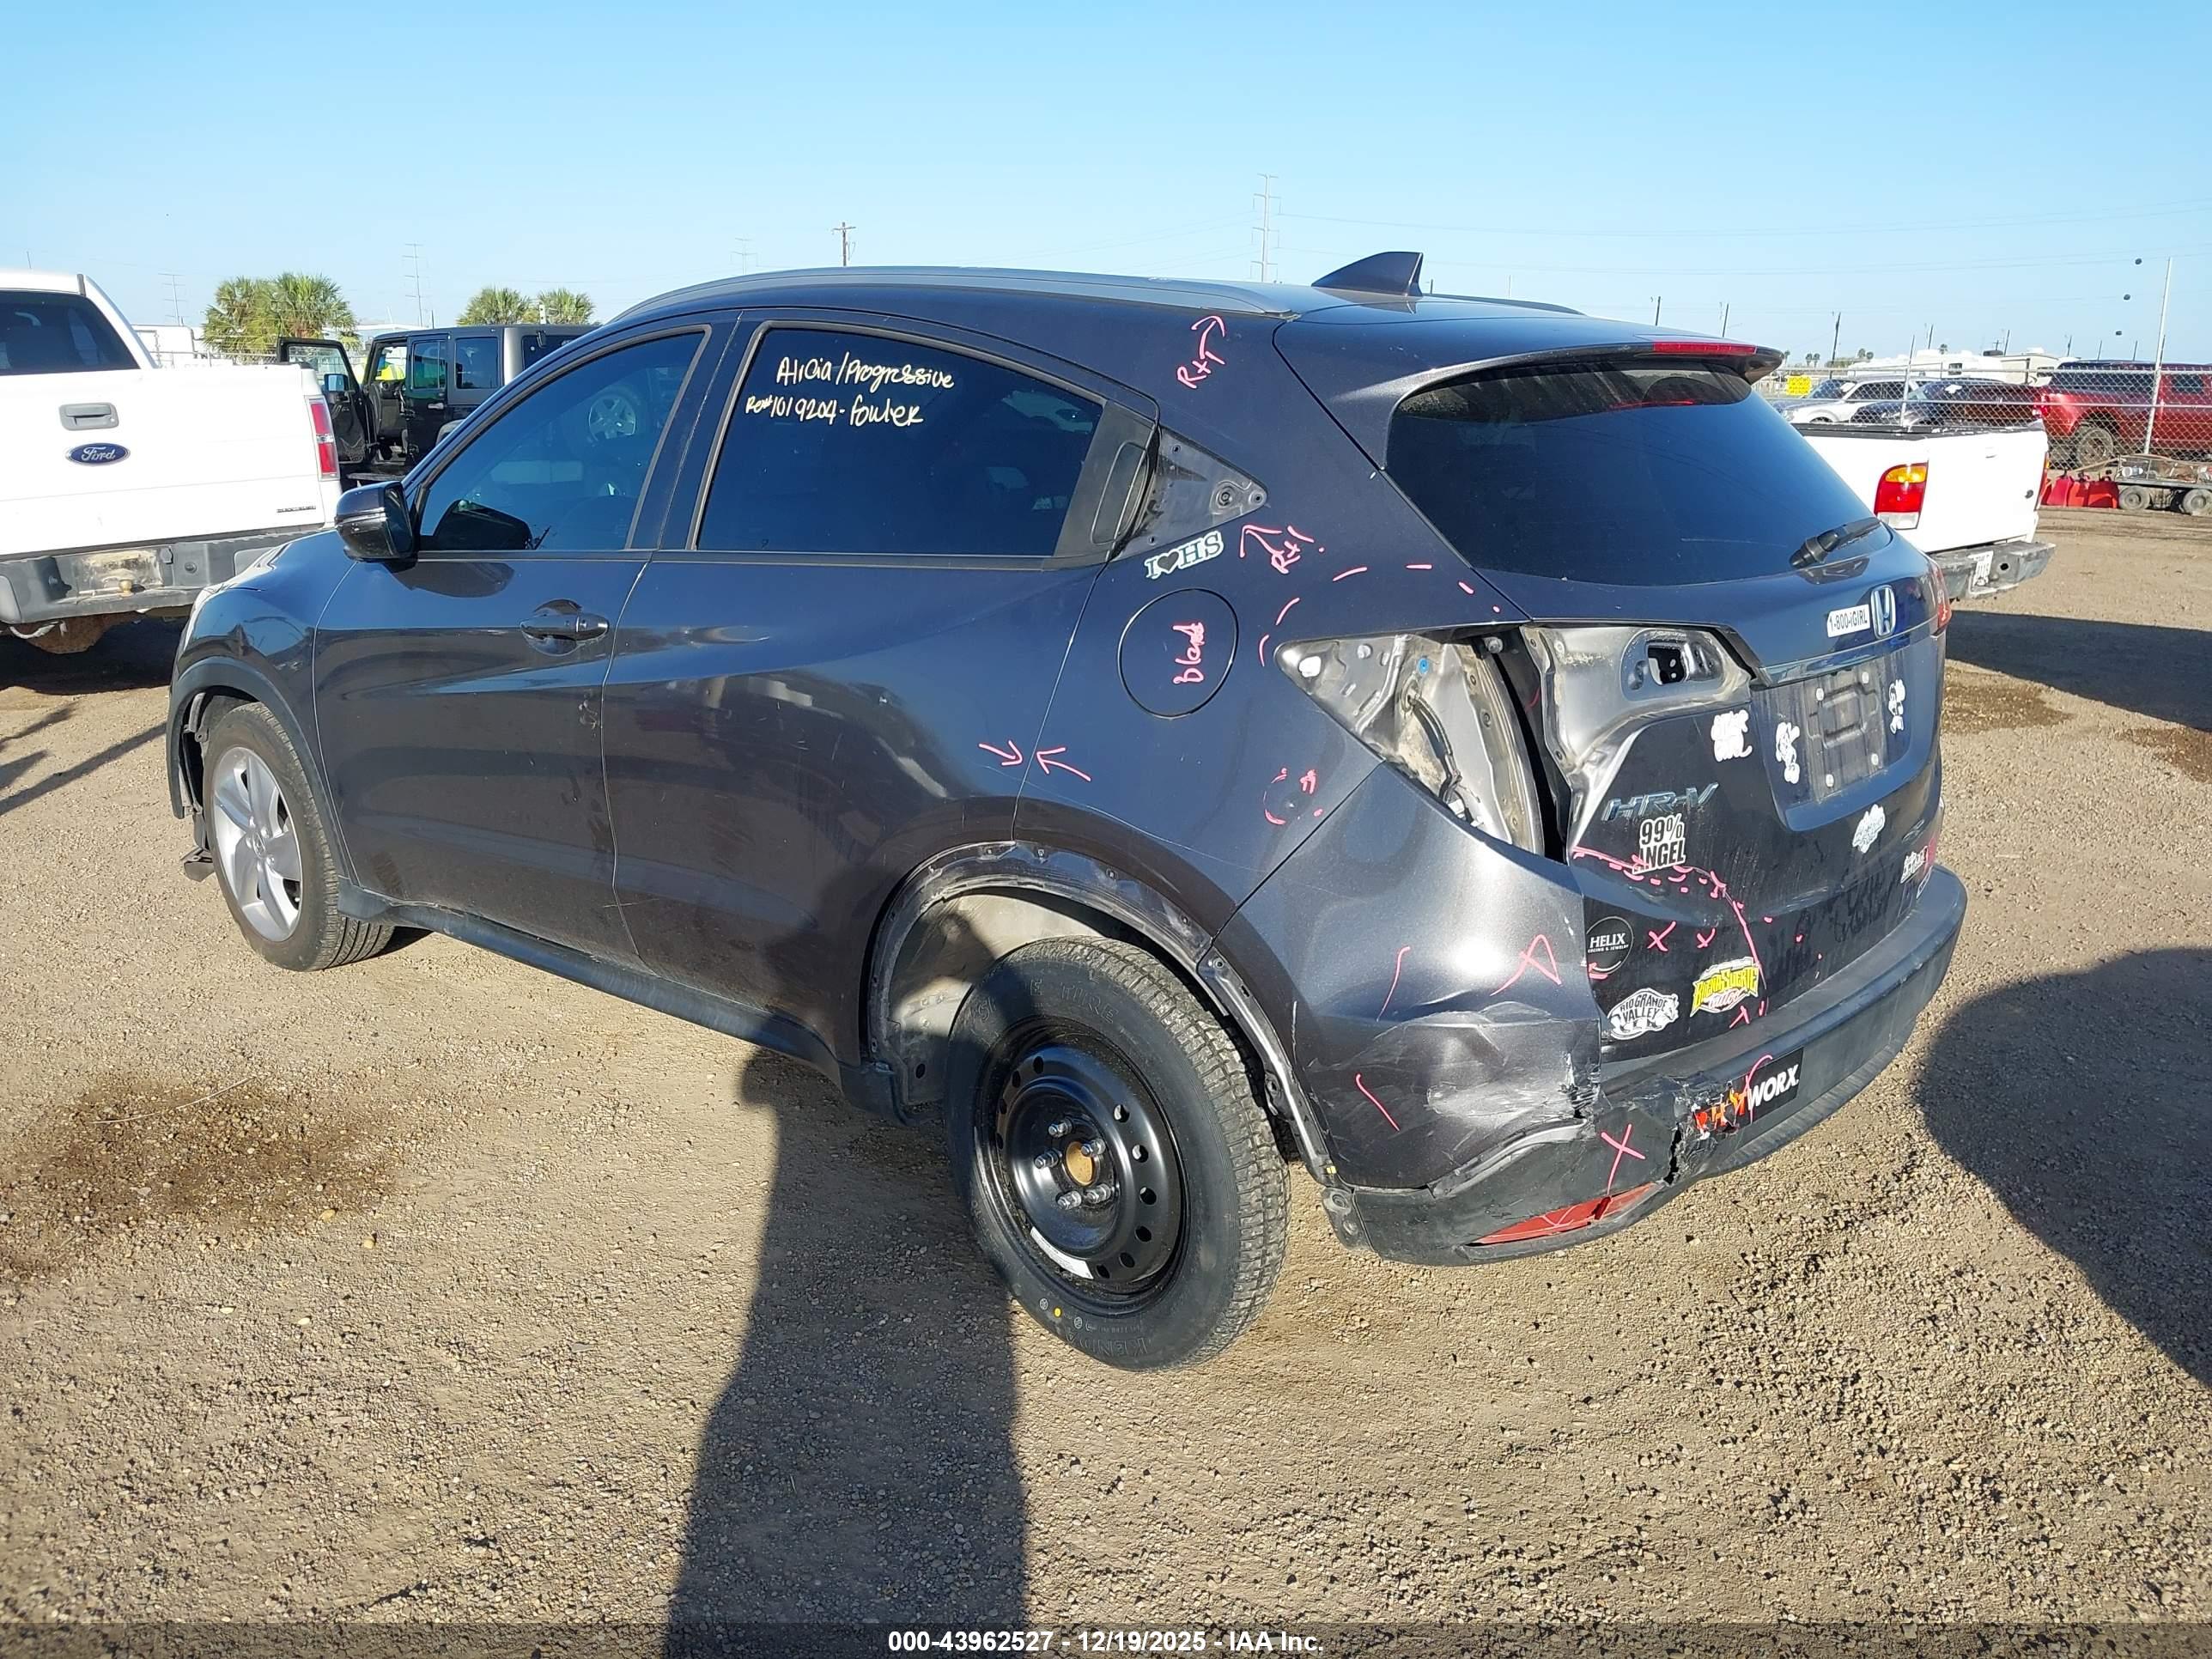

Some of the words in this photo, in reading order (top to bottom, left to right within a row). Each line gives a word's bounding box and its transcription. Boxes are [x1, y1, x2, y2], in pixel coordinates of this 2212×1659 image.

[81, 446, 117, 461] Ford
[1601, 782, 1719, 822] HR-V
[1641, 816, 1683, 846] 99%
[1589, 933, 1626, 949] HELIX
[1620, 998, 1634, 1012] RIO
[1634, 994, 1668, 1012] GRANDE
[1623, 1007, 1660, 1023] VALLEY
